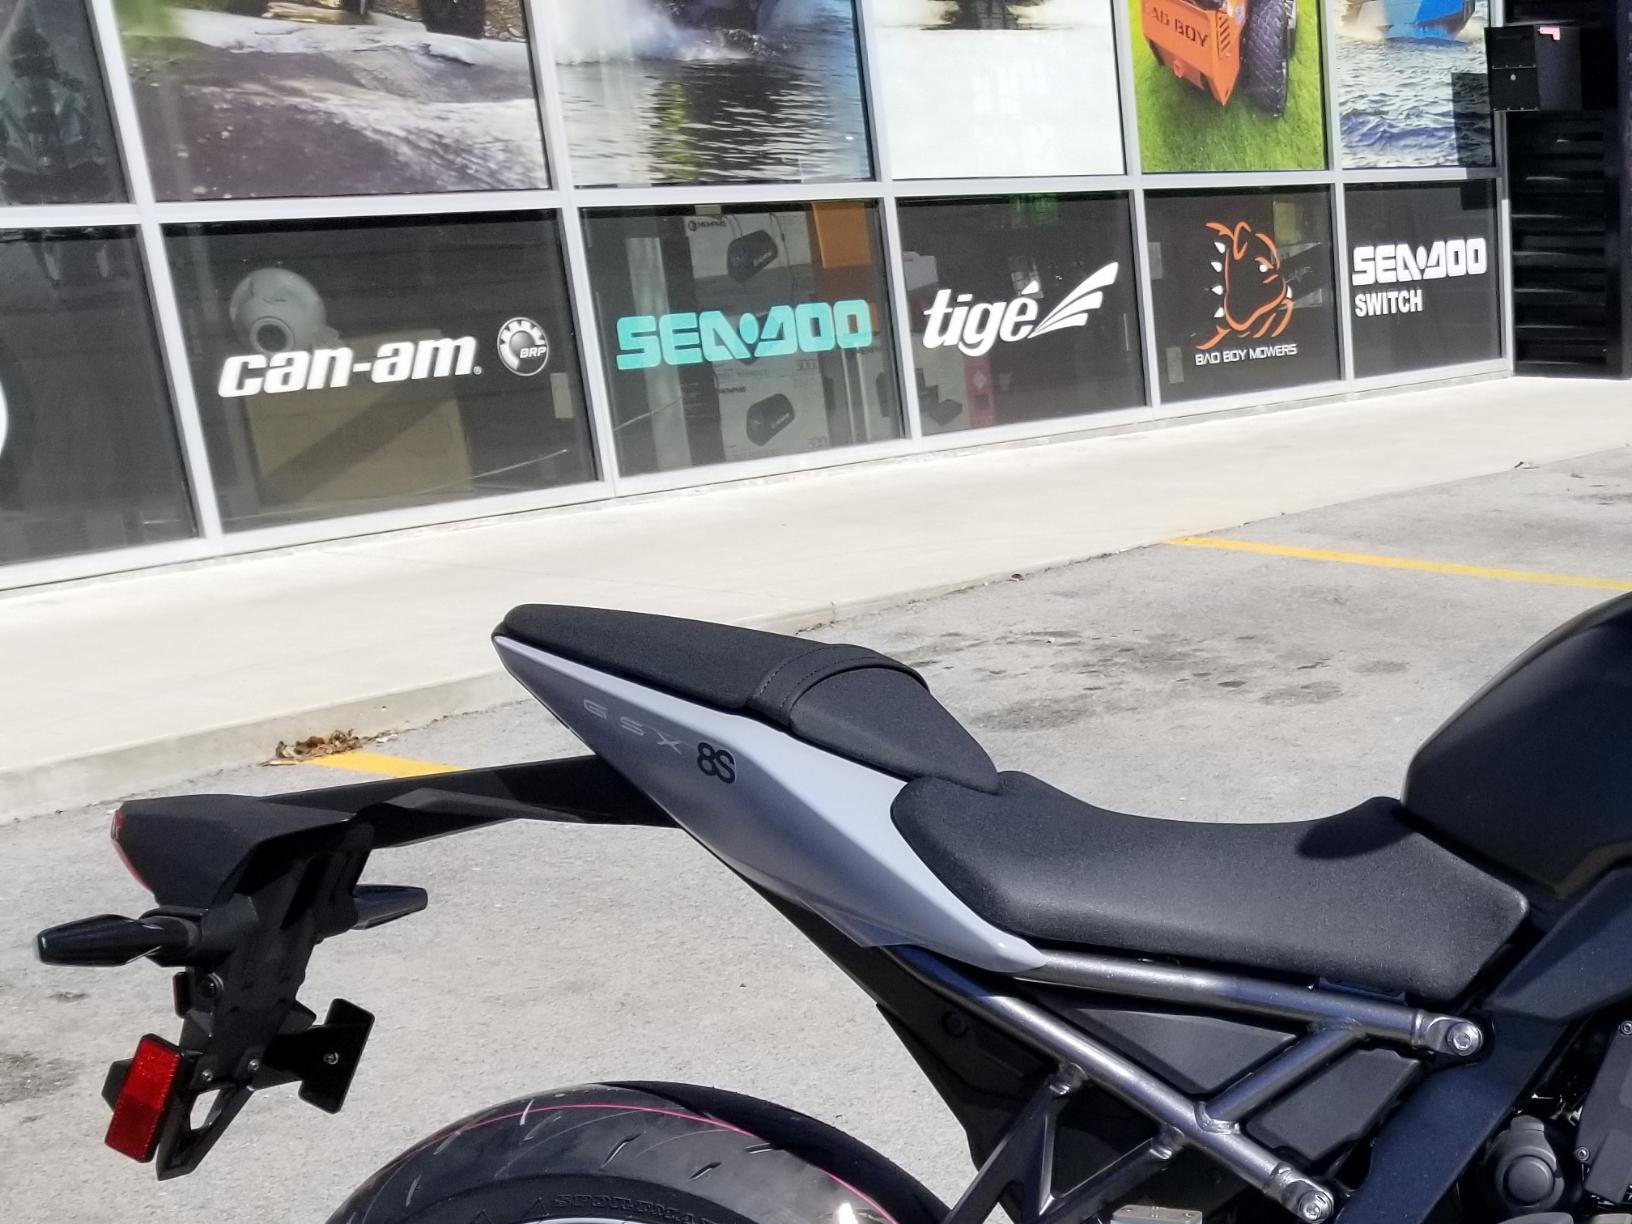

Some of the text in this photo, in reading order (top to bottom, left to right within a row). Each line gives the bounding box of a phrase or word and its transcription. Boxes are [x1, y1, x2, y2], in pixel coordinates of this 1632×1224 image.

[1174, 18, 1208, 47] BOY
[923, 279, 1040, 357] tigé
[1355, 289, 1423, 318] SWITCH
[218, 335, 478, 398] can-am
[519, 345, 548, 359] BRP
[1195, 343, 1299, 366] BAD BOY MOWERS
[697, 741, 737, 785] 8S
